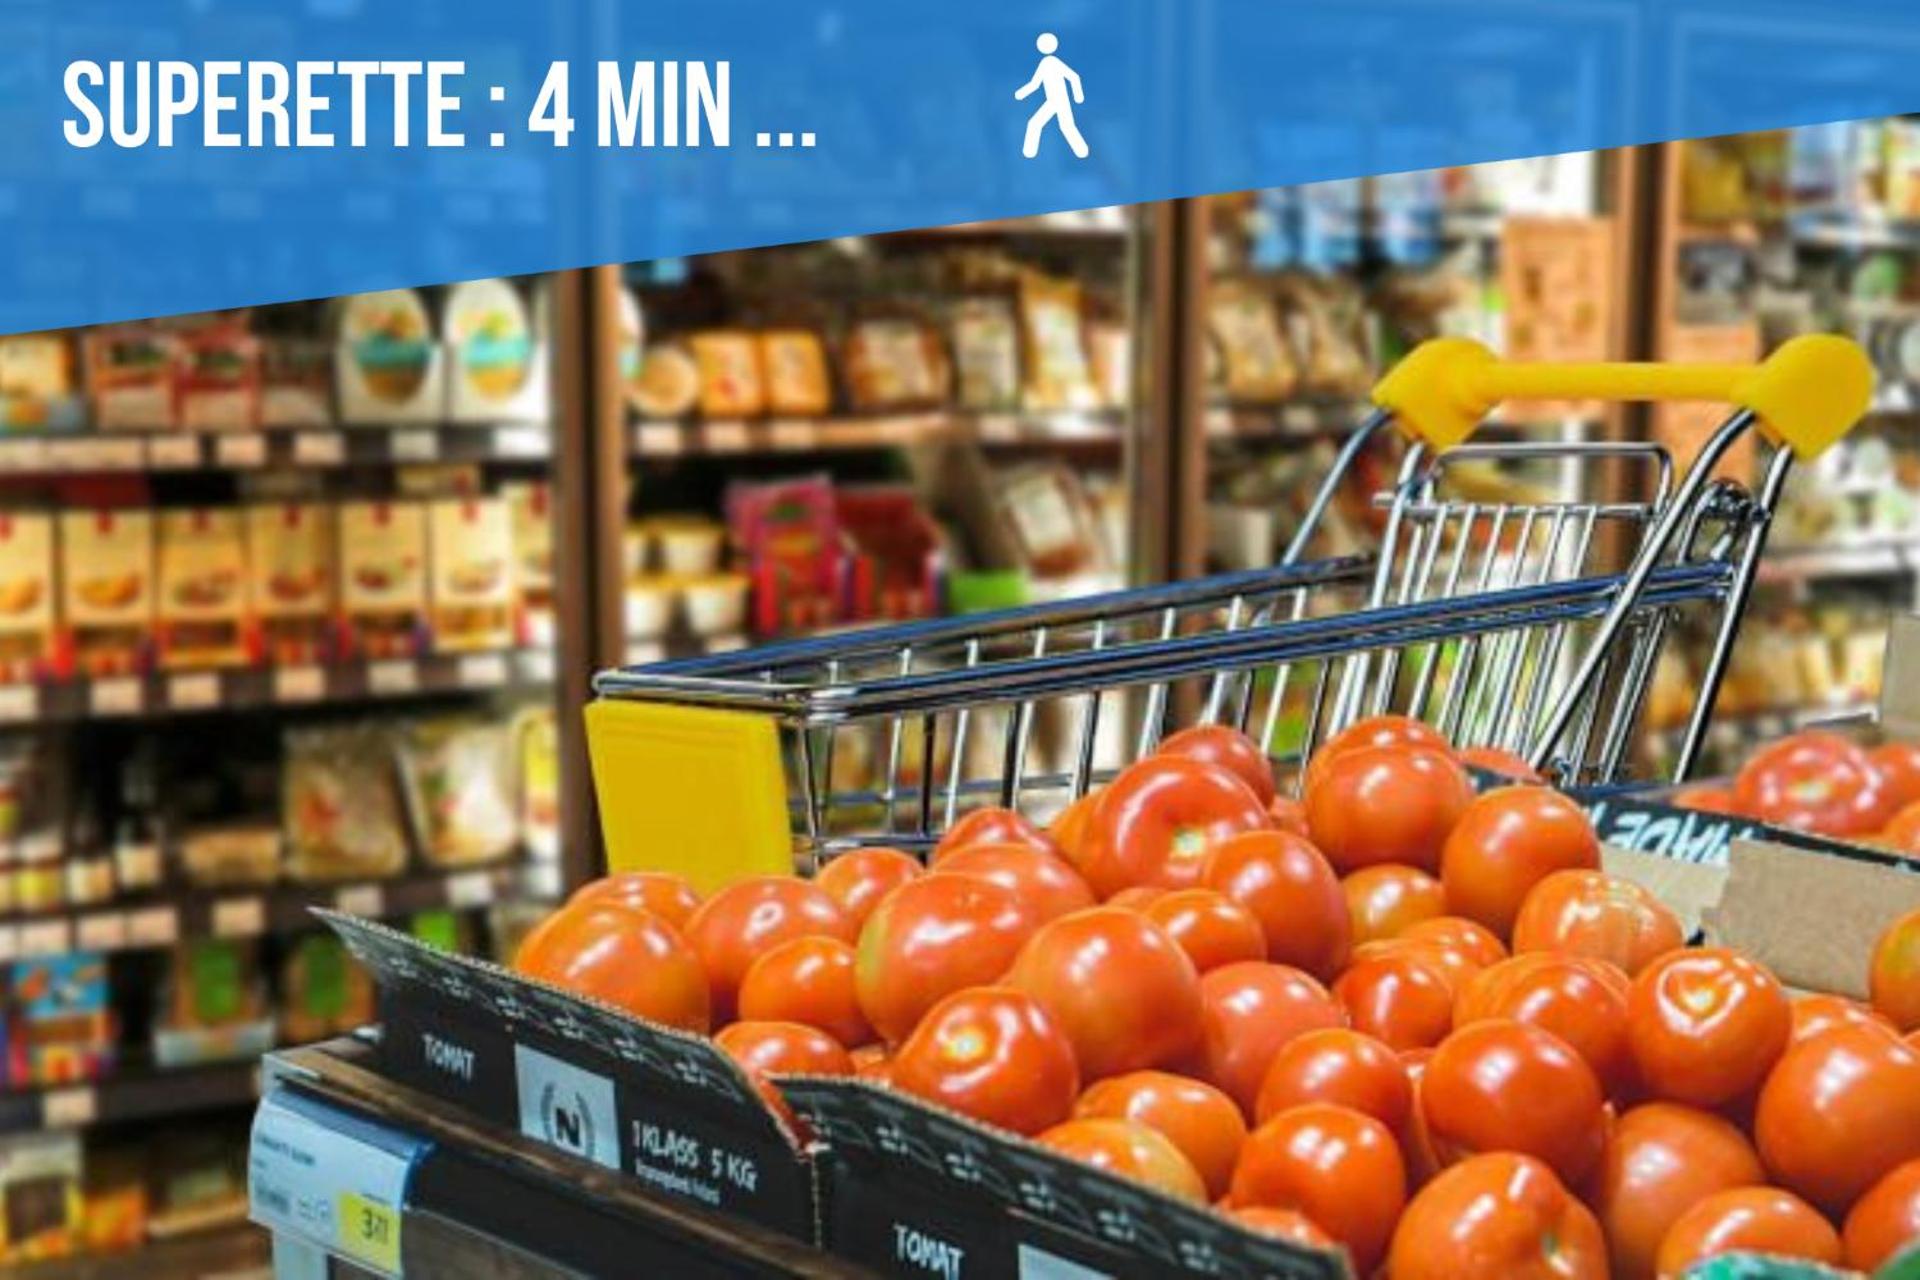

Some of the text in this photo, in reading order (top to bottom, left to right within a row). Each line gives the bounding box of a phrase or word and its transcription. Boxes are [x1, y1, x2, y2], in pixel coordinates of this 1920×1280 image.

[422, 1034, 475, 1082] TOMAT
[556, 1107, 581, 1147] N
[711, 1148, 723, 1178] 5
[894, 1222, 964, 1280] TOMAT
